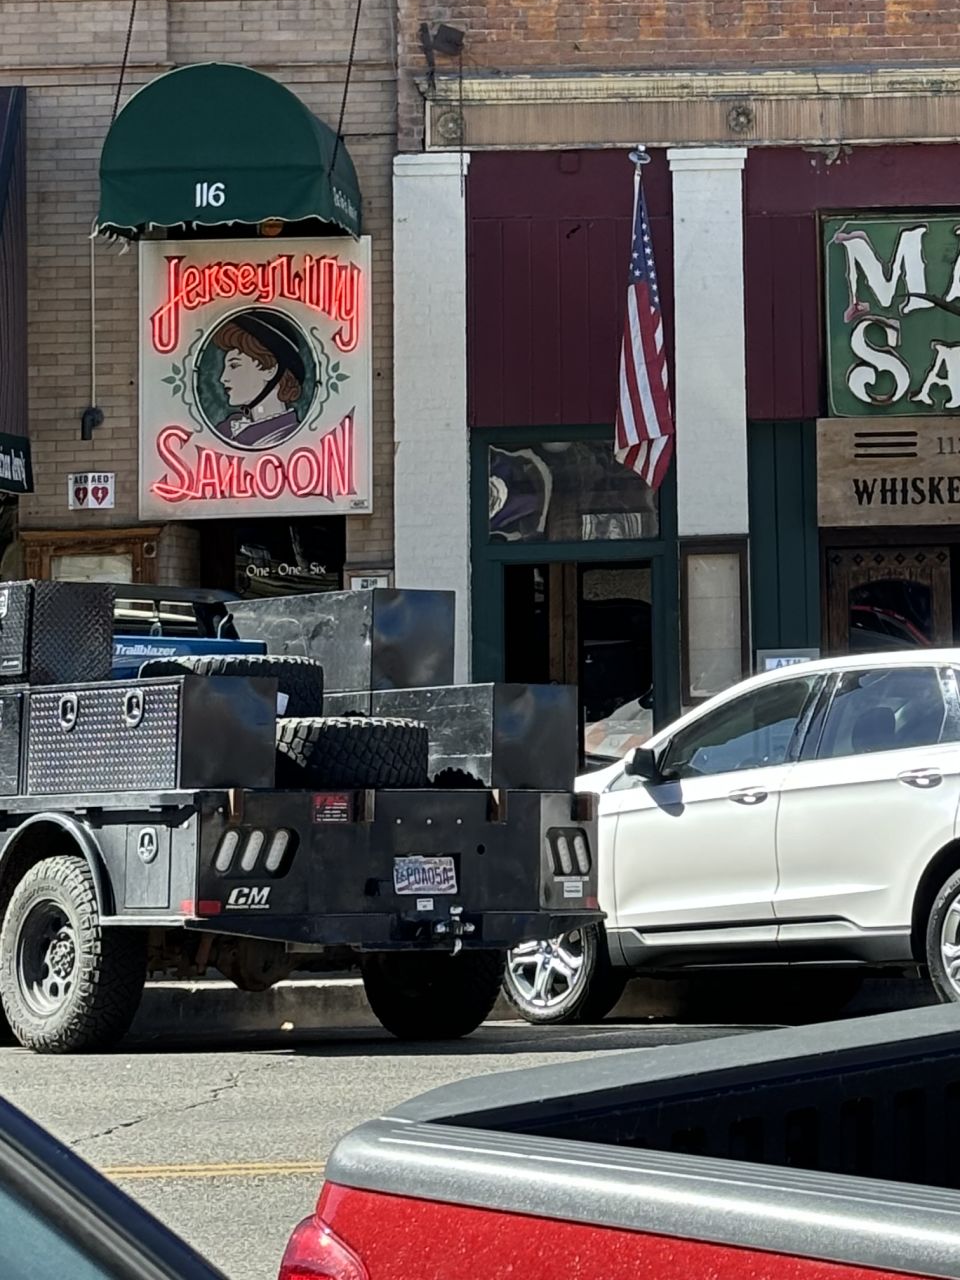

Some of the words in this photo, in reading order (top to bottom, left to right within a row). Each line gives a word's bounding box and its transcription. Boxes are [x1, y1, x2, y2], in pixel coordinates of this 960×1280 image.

[195, 182, 226, 208] 116
[150, 255, 272, 354] Jersey
[74, 475, 88, 484] AED
[91, 475, 109, 483] AED
[246, 564, 269, 576] One
[278, 563, 301, 575] One
[310, 562, 326, 574] Six
